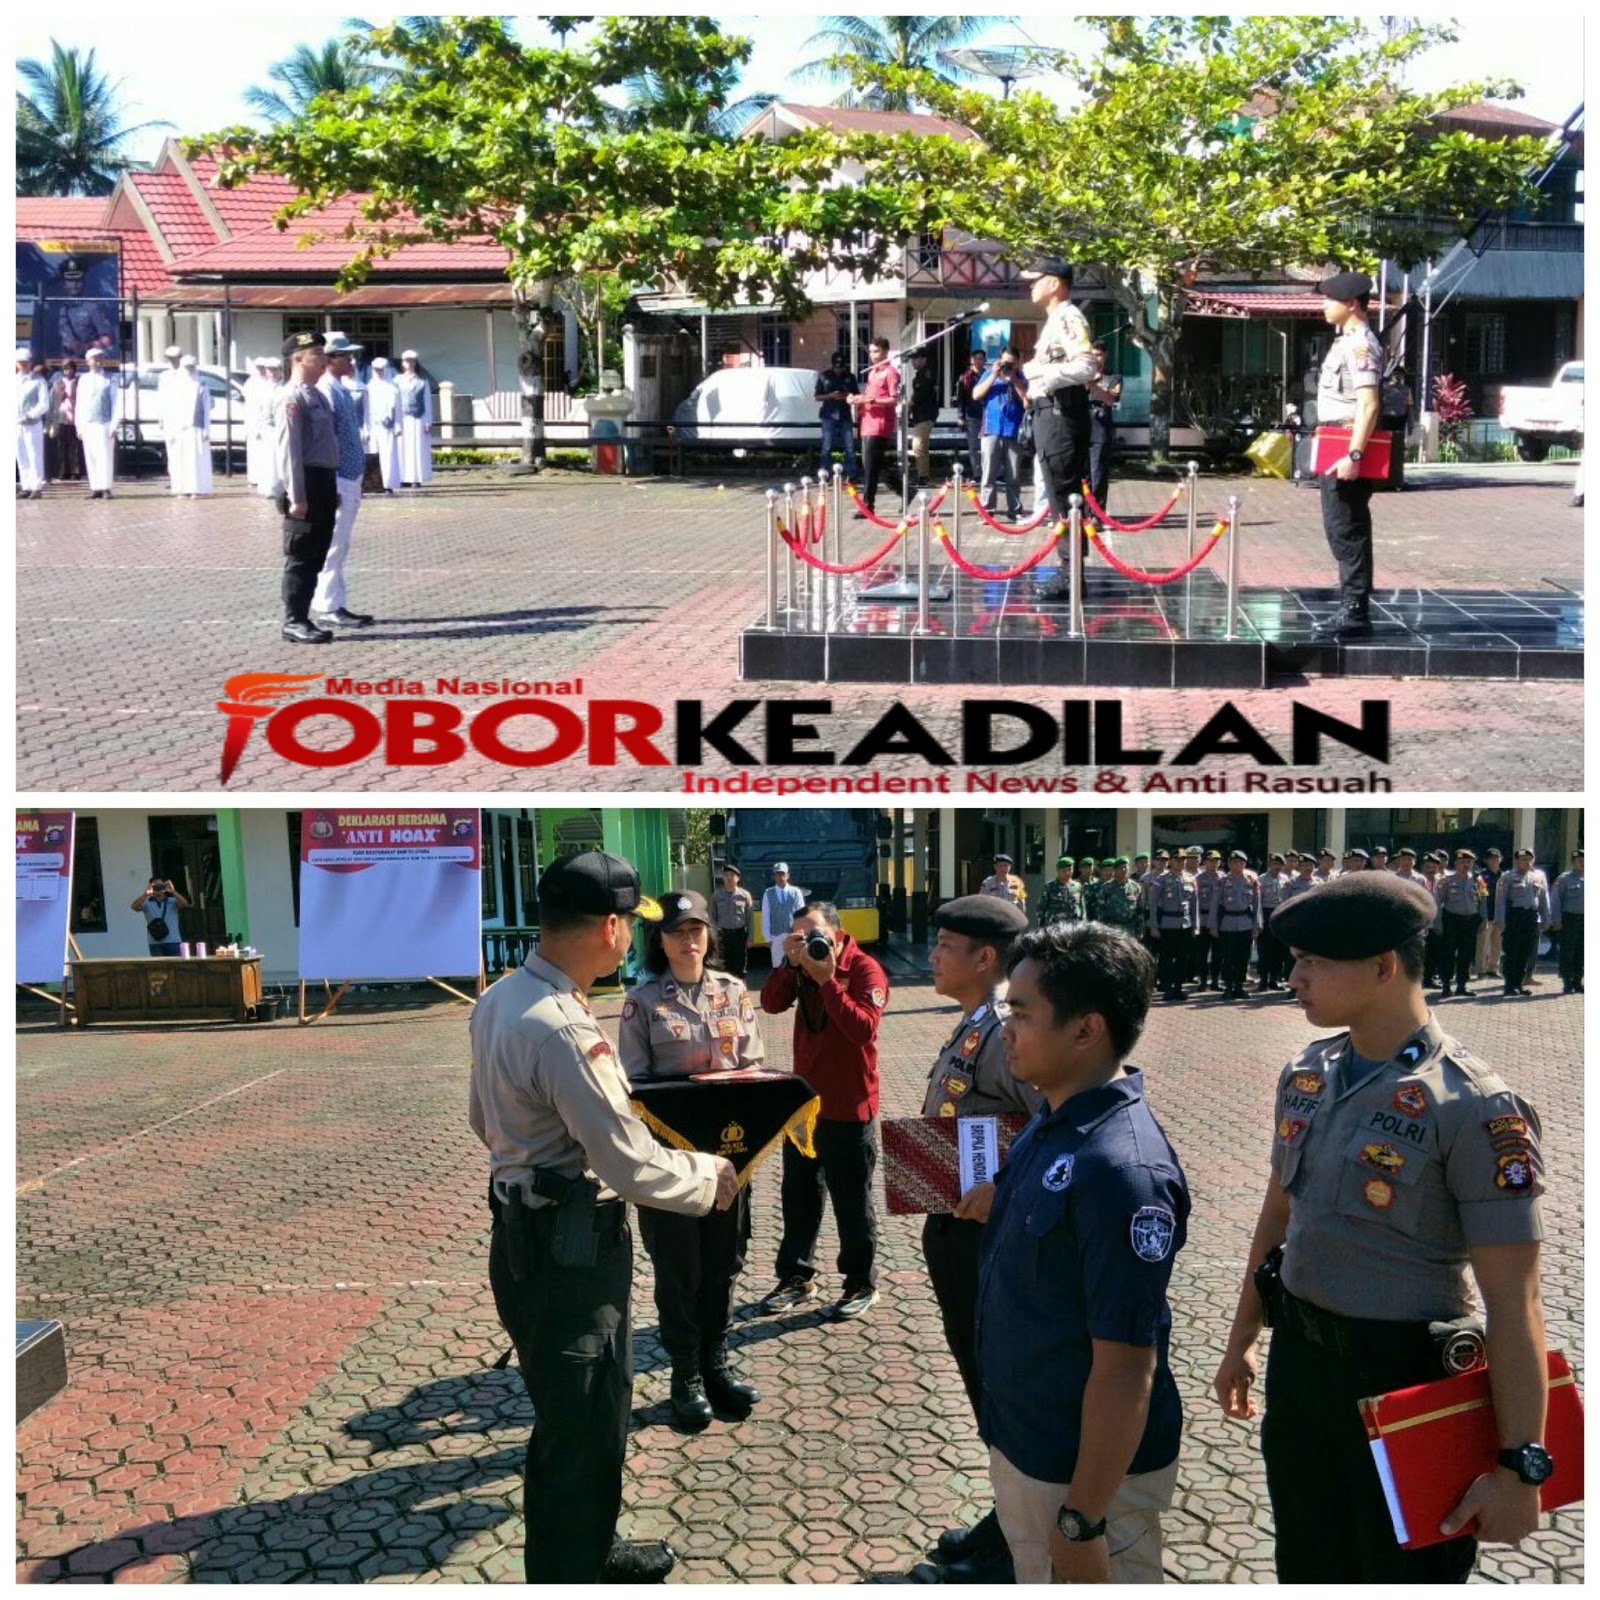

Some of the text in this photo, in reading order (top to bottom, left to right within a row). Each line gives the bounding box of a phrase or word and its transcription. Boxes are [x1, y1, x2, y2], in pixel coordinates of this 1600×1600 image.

[338, 814, 447, 826] DEKLARASI BERSAMA
[1283, 1094, 1320, 1114] HAFIF
[1370, 1111, 1426, 1144] POLRI
